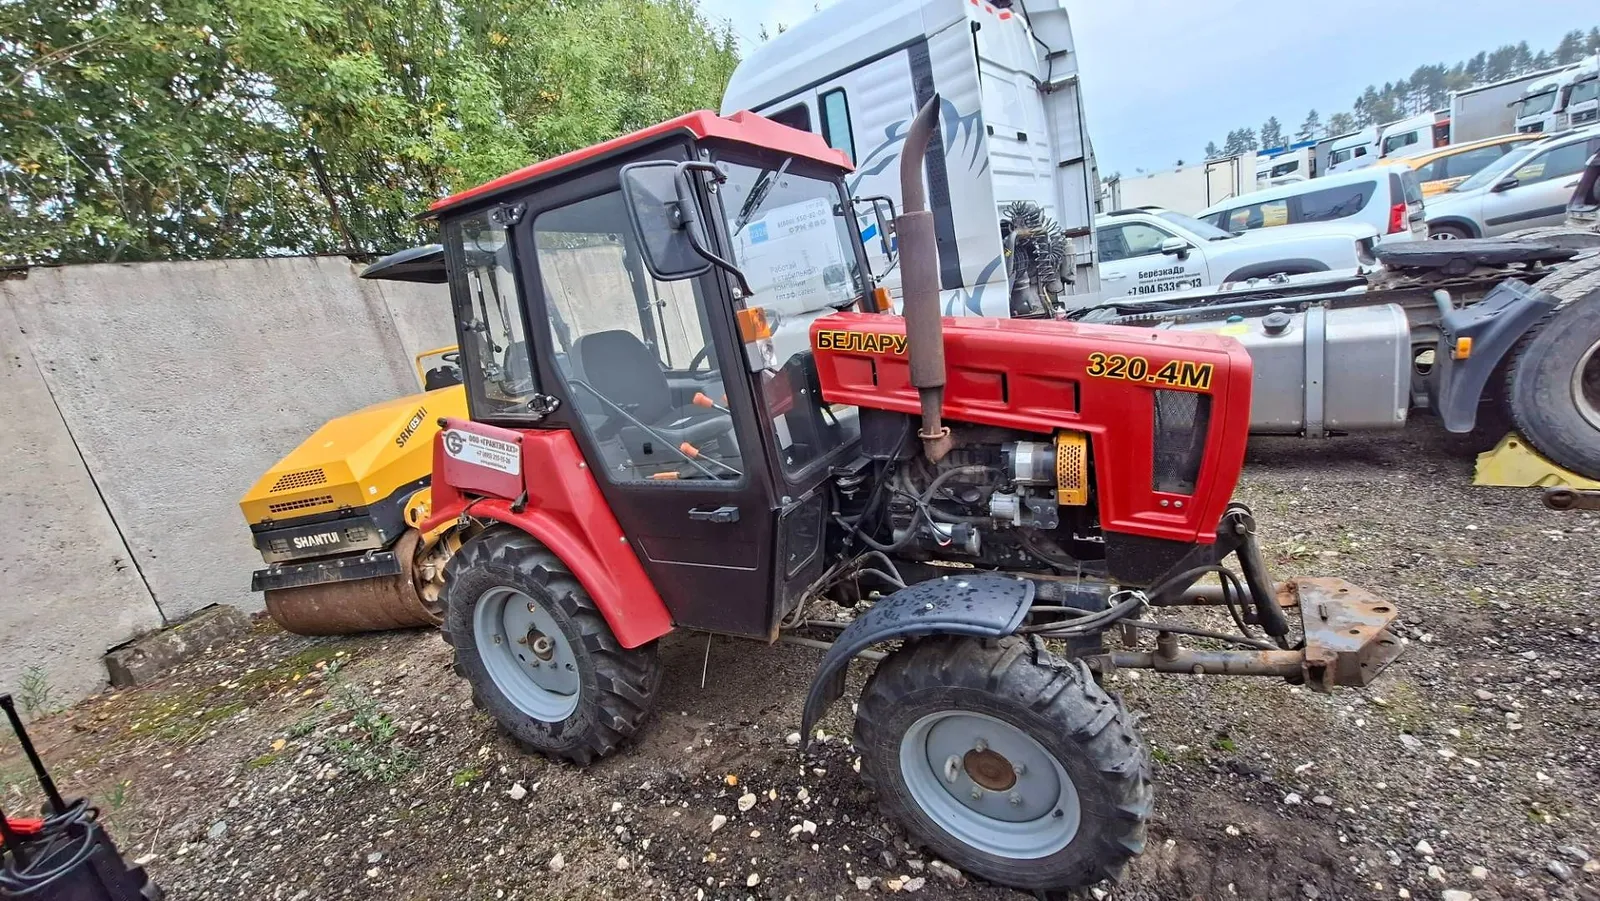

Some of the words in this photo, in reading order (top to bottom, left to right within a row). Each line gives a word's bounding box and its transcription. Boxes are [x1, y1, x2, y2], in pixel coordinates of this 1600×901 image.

[1128, 287, 1137, 296] +7
[1138, 285, 1155, 295] 904
[1157, 282, 1175, 293] 633
[1192, 278, 1202, 288] 13
[817, 329, 908, 355] БЕЛАРУ
[293, 531, 340, 549] SHANTUI
